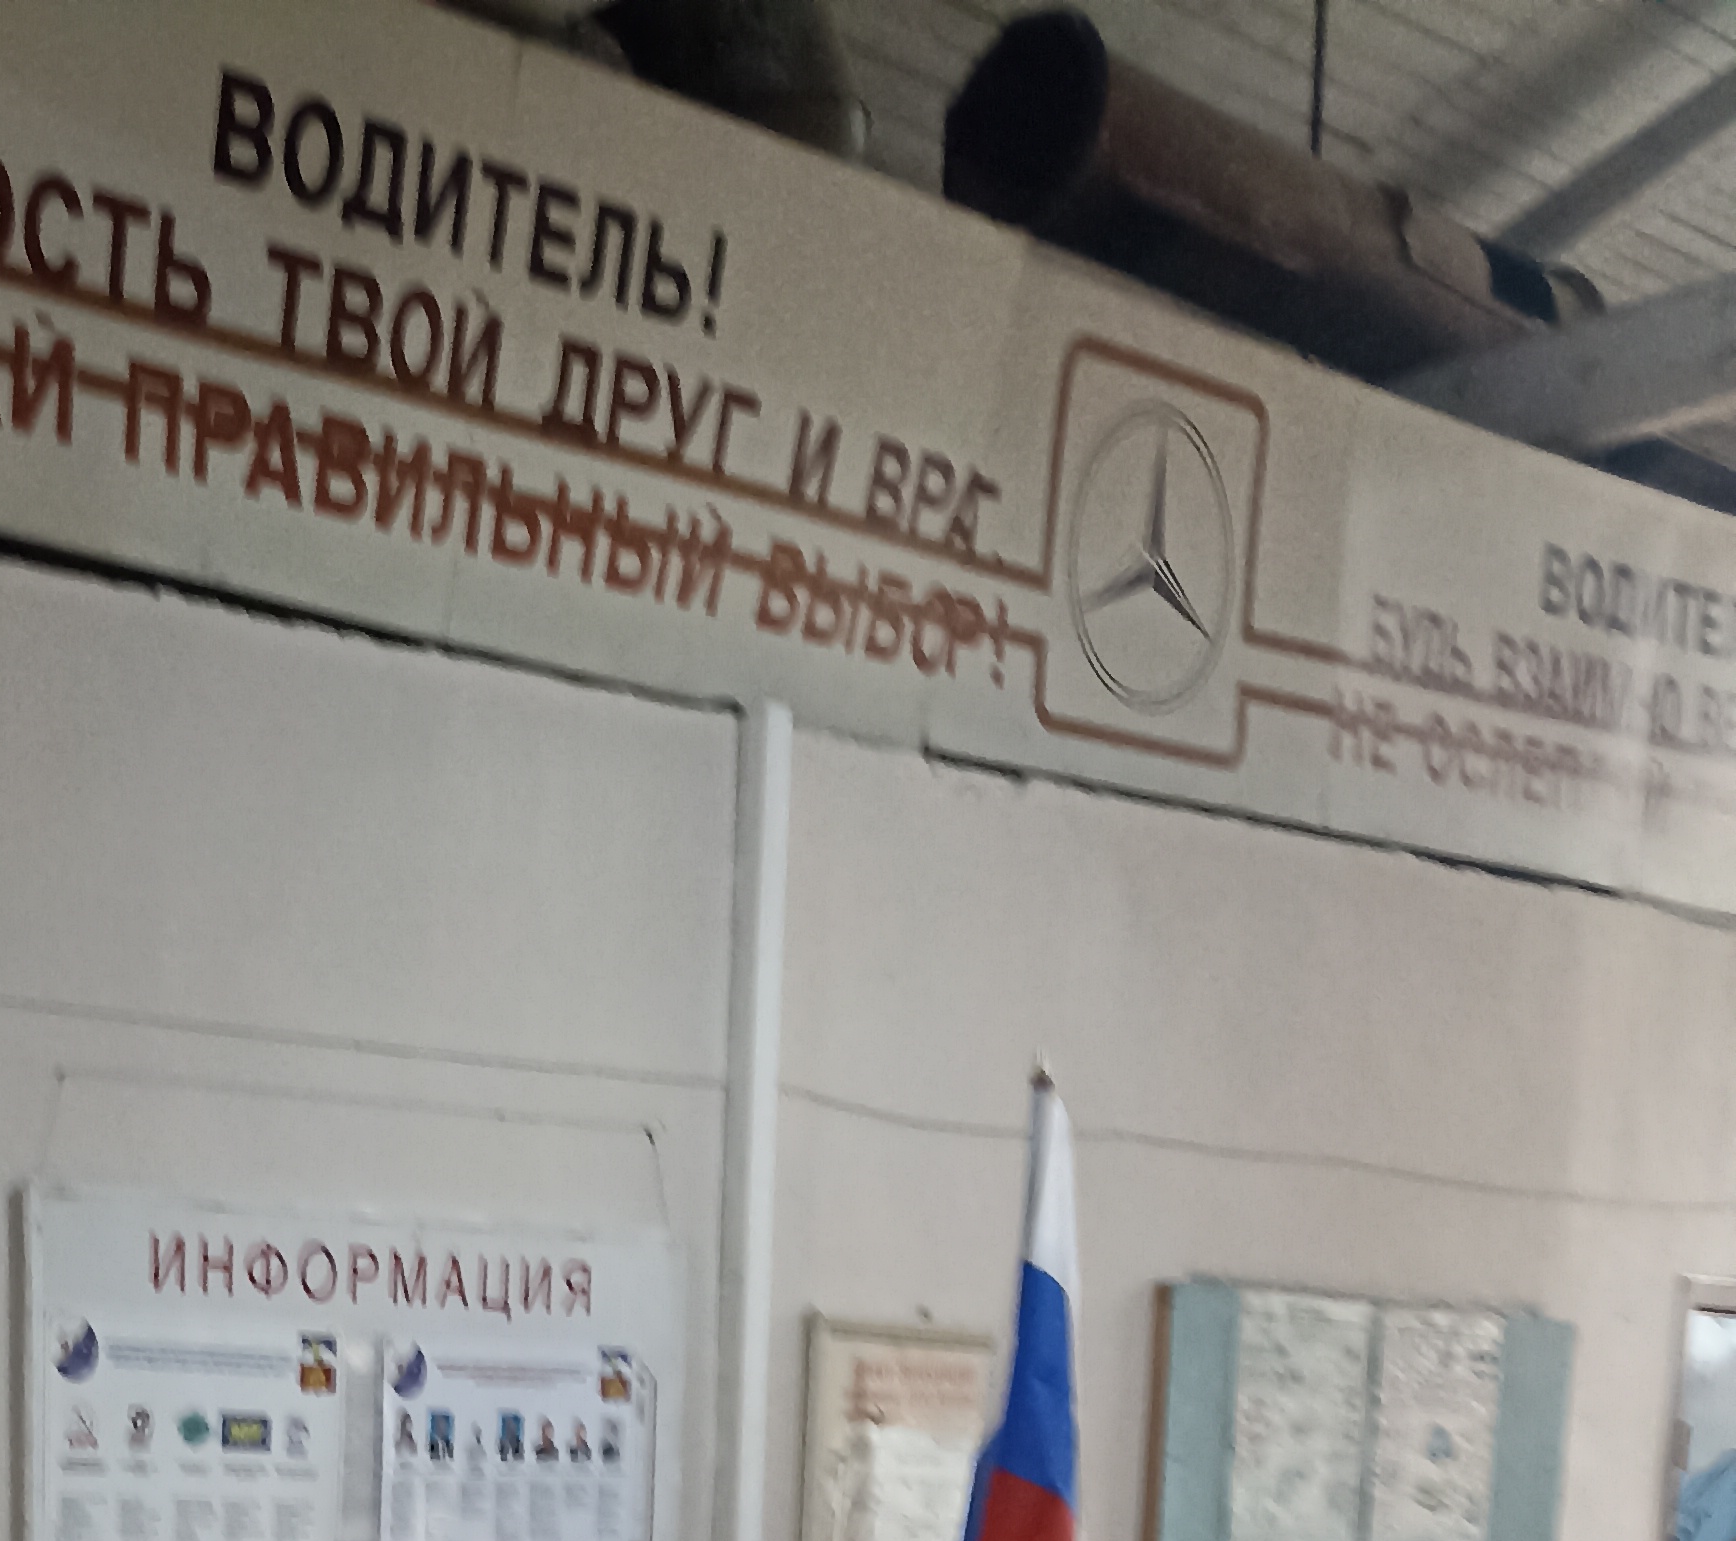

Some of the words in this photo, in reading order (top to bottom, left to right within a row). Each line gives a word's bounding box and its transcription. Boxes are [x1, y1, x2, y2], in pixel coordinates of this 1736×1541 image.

[211, 66, 730, 340] ВОДИТЕЛЬ!
[265, 242, 506, 415] ТВОЙ
[539, 330, 764, 480] ДРУГ
[786, 402, 844, 510] И
[119, 356, 736, 620] ПРАВИЛЬНЫЙ
[753, 535, 1009, 690] ВЫБОР!
[147, 1228, 594, 1322] ИНФОРМАЦИЯ
